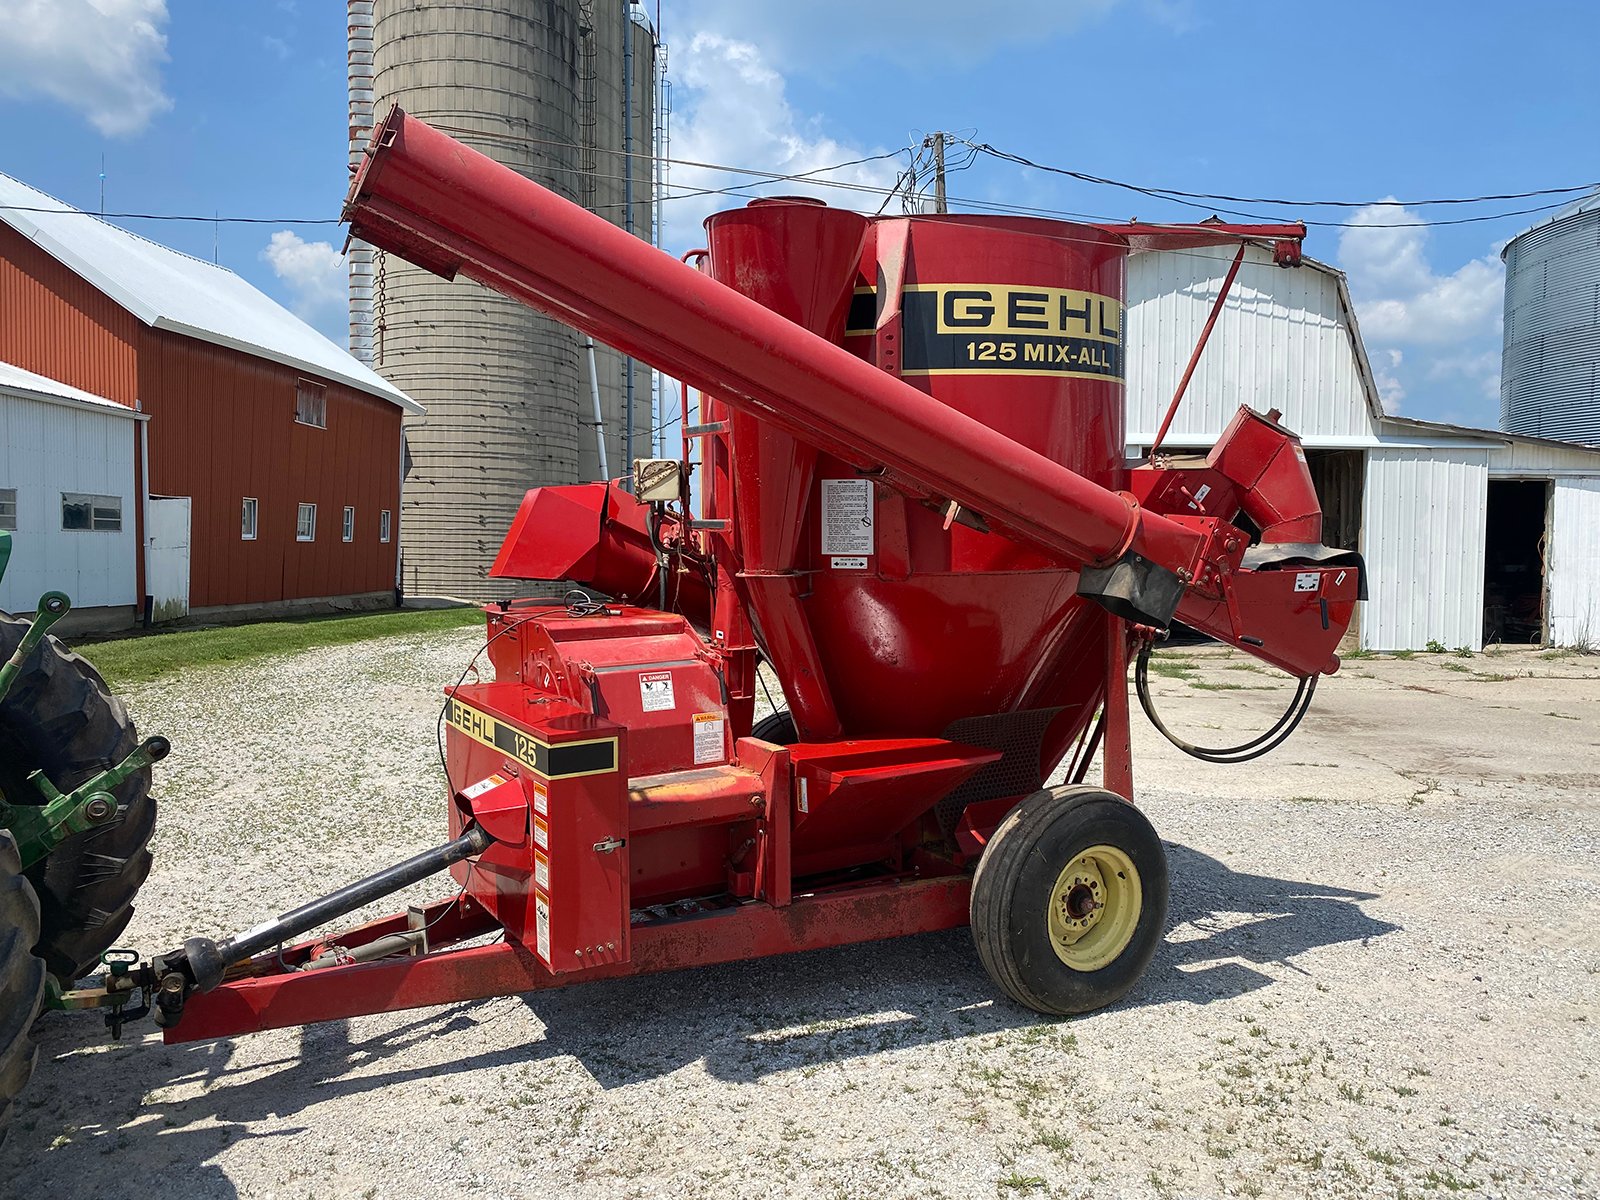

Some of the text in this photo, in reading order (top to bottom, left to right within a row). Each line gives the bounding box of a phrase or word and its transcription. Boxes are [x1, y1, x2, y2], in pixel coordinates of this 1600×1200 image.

[943, 290, 1119, 339] GEHL
[966, 342, 1111, 369] 125 MIX-ALL
[454, 704, 537, 767] GEHL 125
